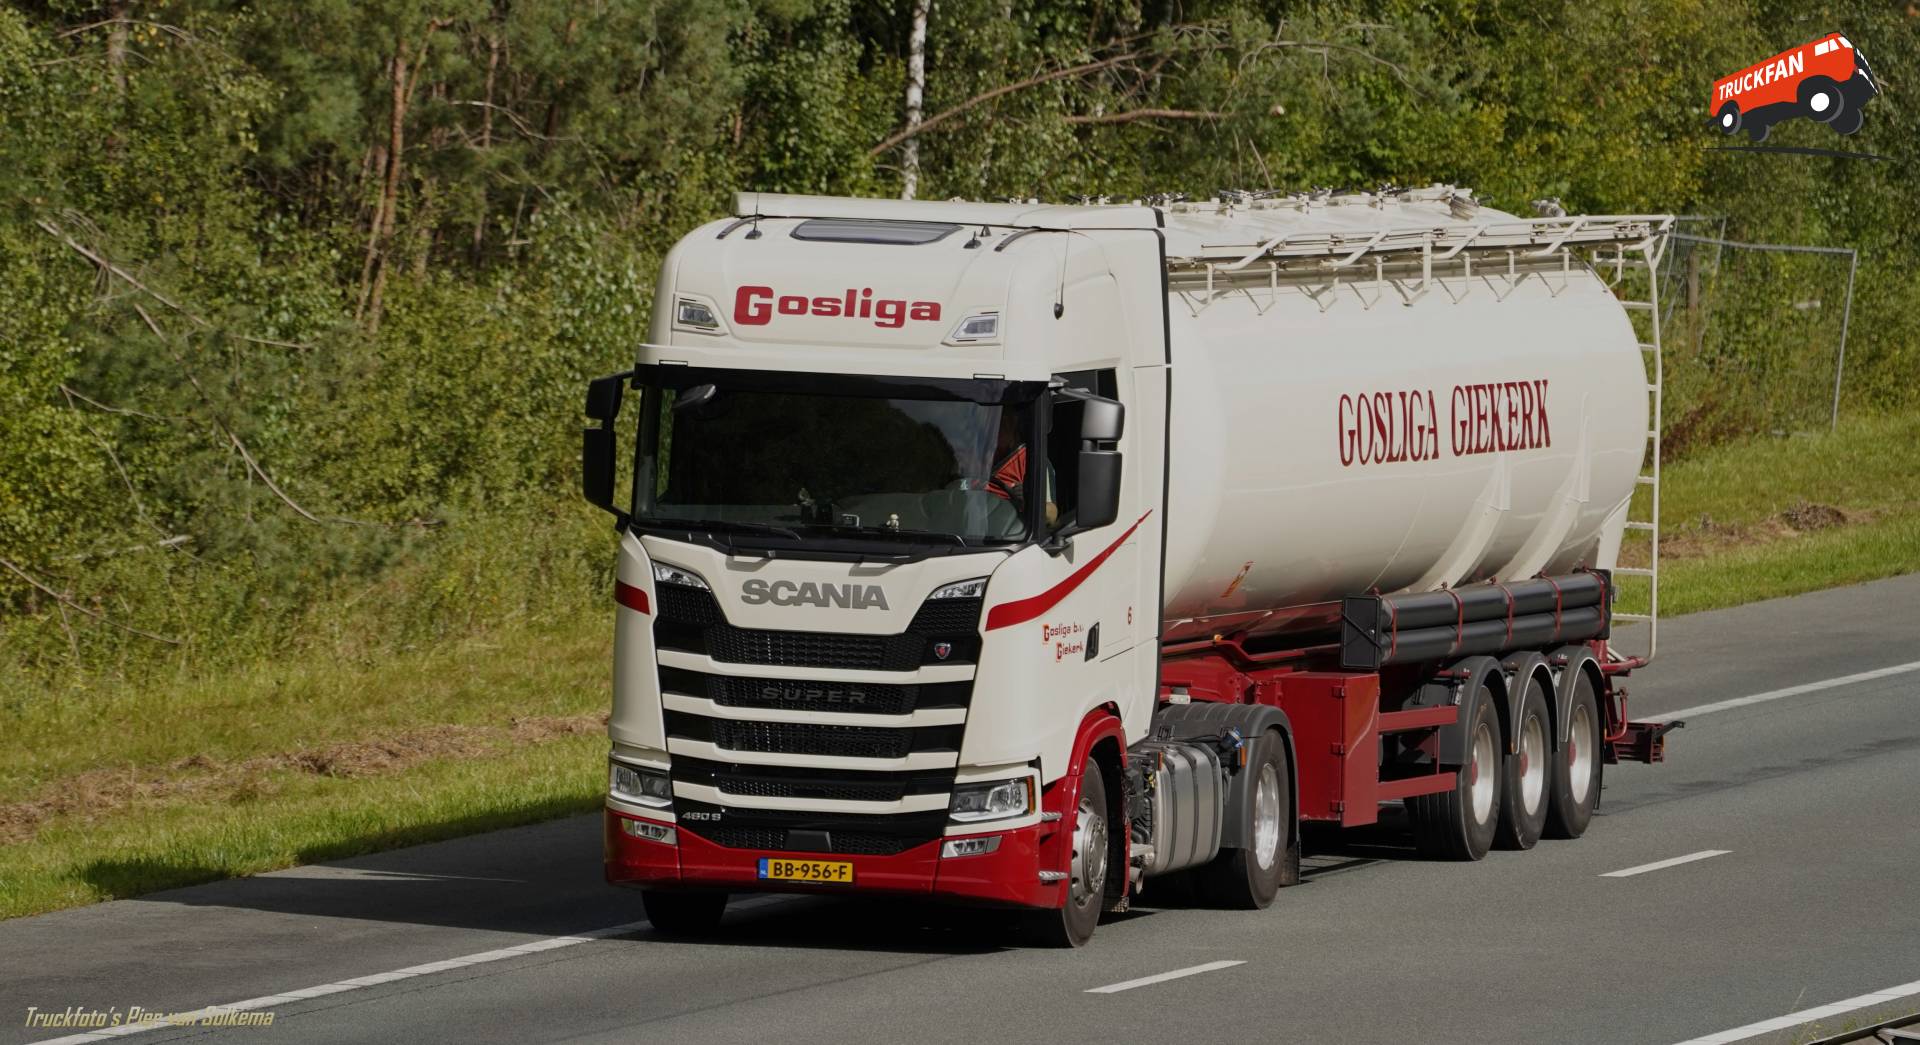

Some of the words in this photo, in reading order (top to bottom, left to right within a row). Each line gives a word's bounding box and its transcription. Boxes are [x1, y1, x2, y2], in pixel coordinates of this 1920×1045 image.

[734, 285, 941, 328] Gosliga
[1338, 390, 1439, 467] GOSLIGA
[1450, 379, 1551, 457] GIEKERK
[741, 578, 890, 611] SCANIA
[1127, 606, 1133, 625] 6
[1043, 623, 1071, 642] Gosliga
[1056, 641, 1084, 660] Giekerk
[762, 687, 866, 704] SUPER
[773, 861, 848, 880] BB-956-F
